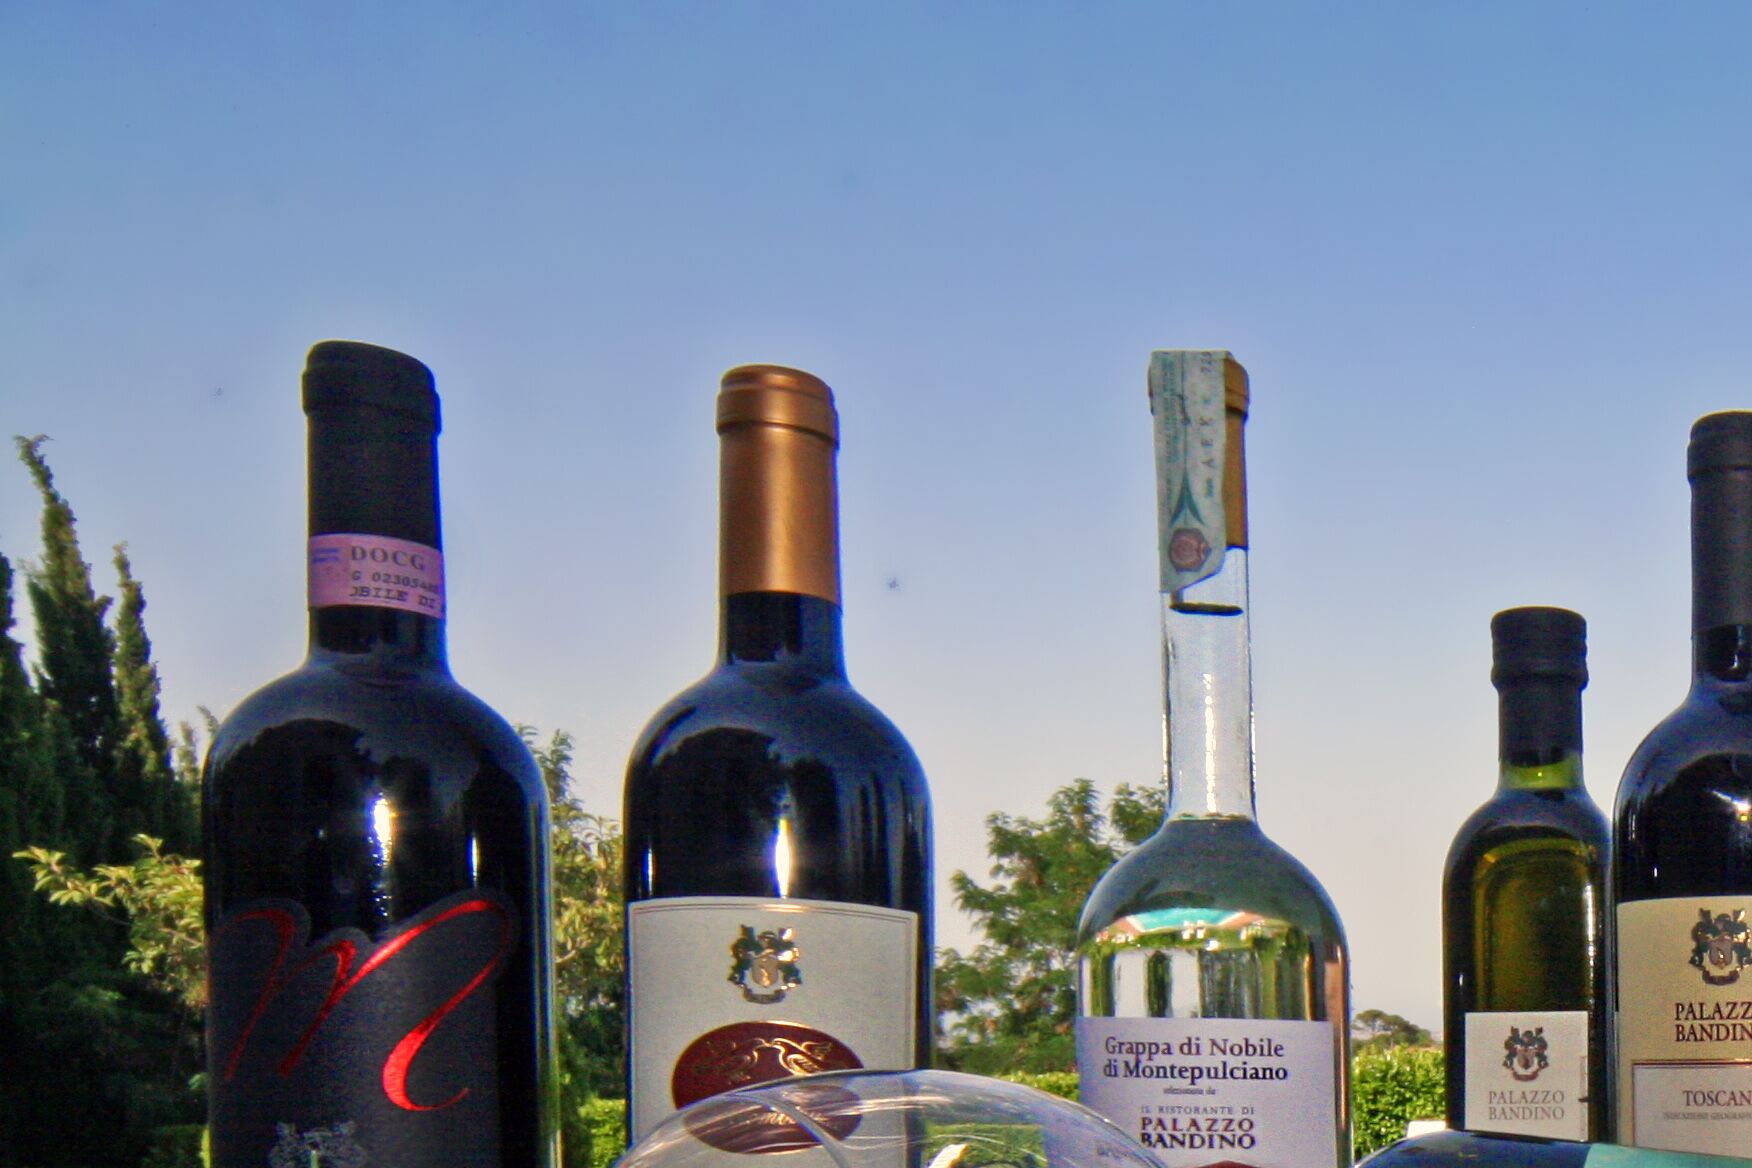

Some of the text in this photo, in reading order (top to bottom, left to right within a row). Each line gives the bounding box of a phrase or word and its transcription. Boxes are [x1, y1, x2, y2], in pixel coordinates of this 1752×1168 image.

[351, 545, 425, 571] DOCG
[1105, 1036, 1285, 1061] Grappa di Nobile
[1103, 1059, 1288, 1085] di Montepulciano
[1488, 1090, 1565, 1105] PALAZZO
[1158, 1105, 1234, 1115] RISTORANTE
[1241, 1106, 1255, 1115] DI
[1488, 1106, 1565, 1121] BANDINO
[1140, 1116, 1255, 1133] PALAZZO
[1140, 1132, 1257, 1150] BANDINO
